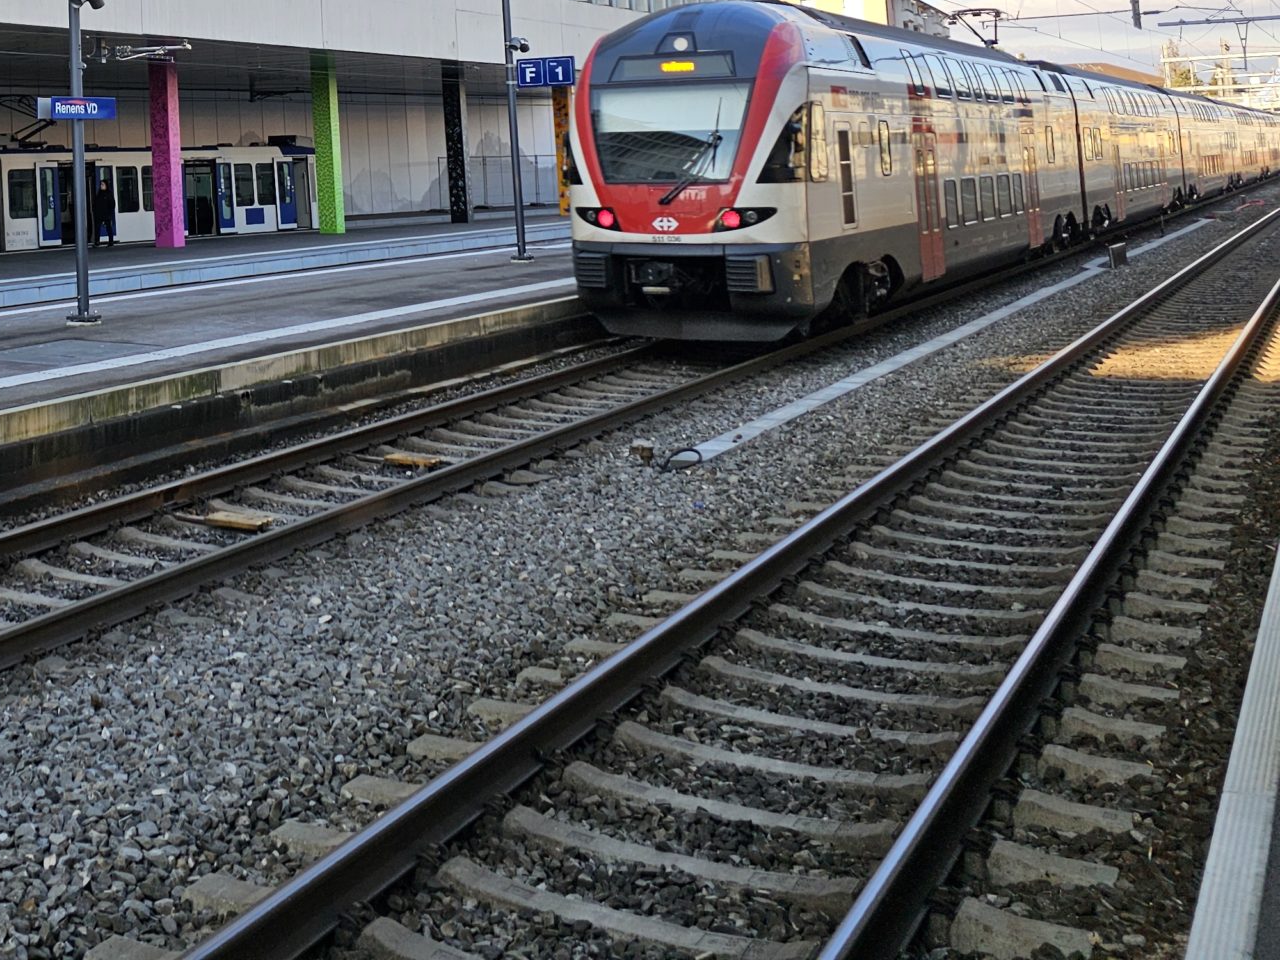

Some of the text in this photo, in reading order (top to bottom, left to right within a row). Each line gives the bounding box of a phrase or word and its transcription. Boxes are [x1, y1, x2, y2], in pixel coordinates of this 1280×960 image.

[525, 68, 536, 82] F
[555, 66, 563, 81] 1
[55, 102, 98, 114] Renens VD
